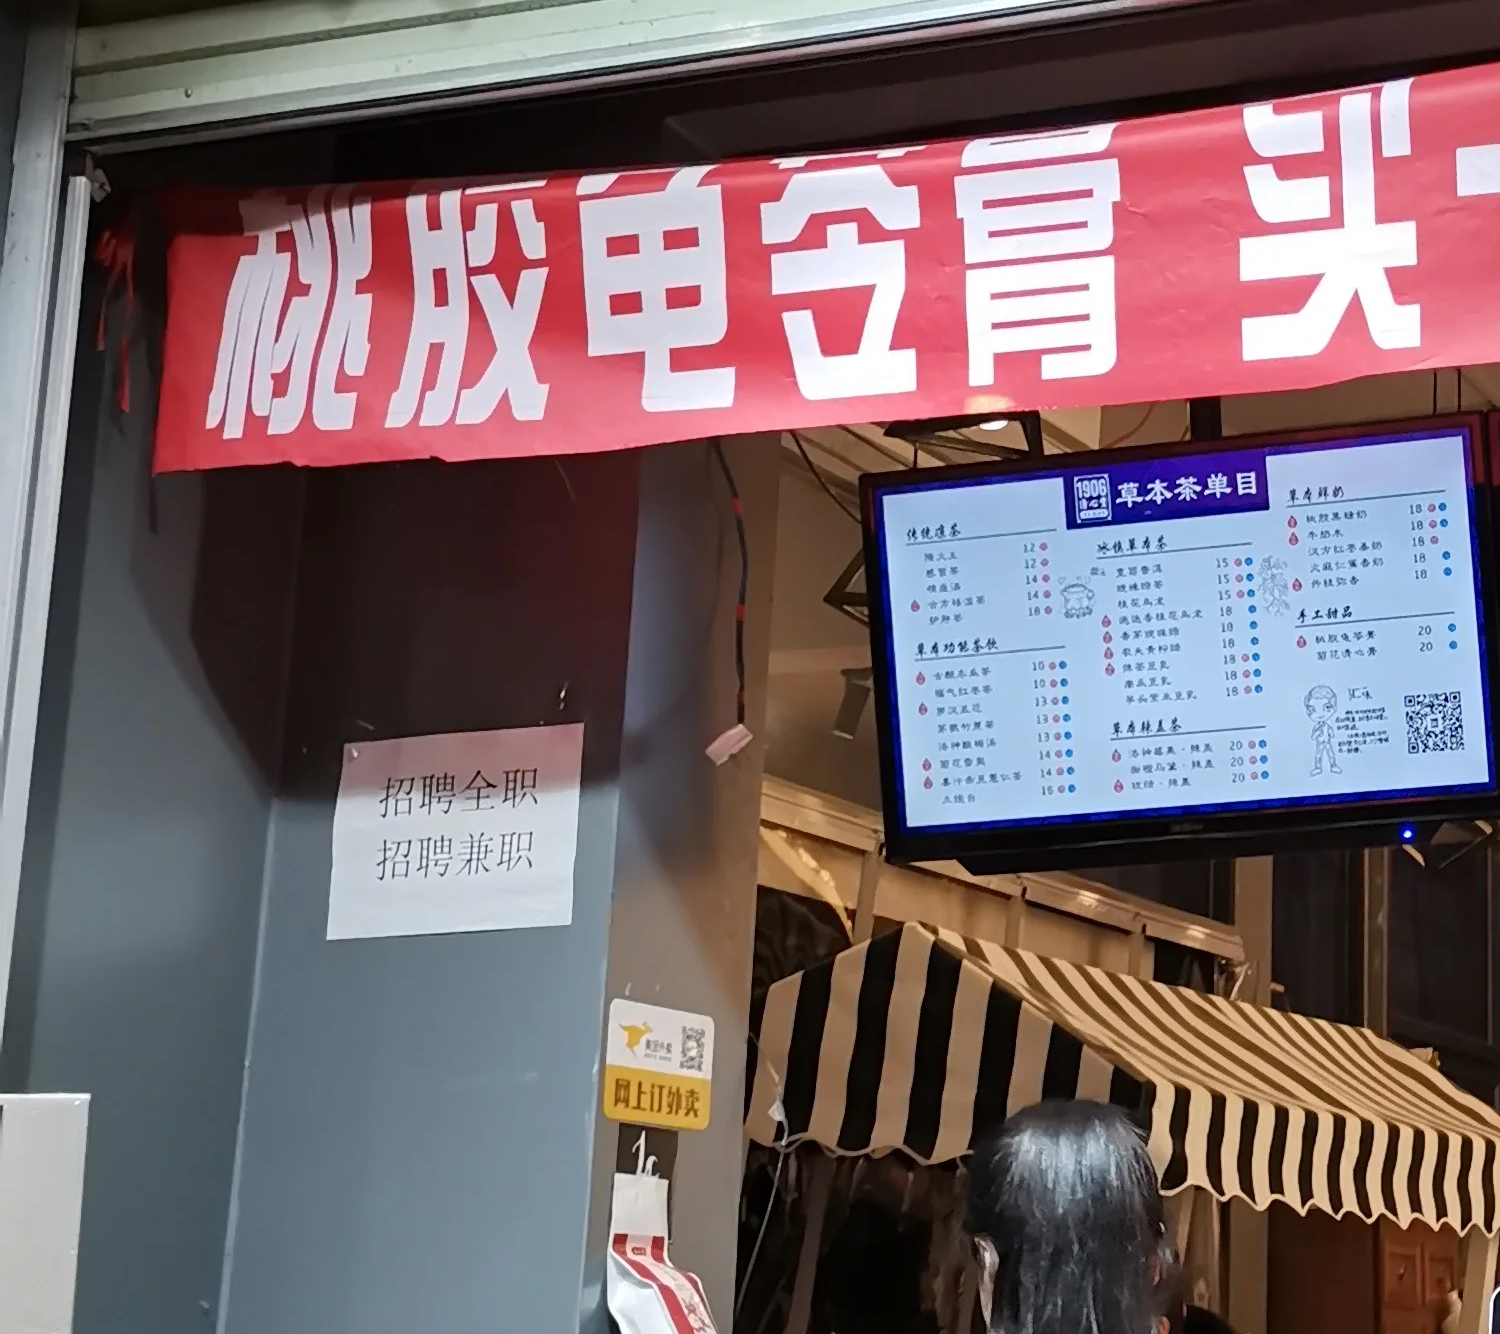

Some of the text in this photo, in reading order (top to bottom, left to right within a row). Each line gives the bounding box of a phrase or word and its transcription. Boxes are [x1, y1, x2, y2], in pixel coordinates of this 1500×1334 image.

[206, 123, 1121, 440] 桃胶龟苓膏
[1076, 478, 1108, 499] 1906
[1115, 470, 1257, 509] 草本茶单目
[1215, 557, 1229, 568] 15
[1413, 552, 1426, 563] 18
[1217, 574, 1230, 585] 15
[1219, 590, 1231, 601] 15
[1297, 605, 1353, 623] 手工甜品
[1418, 625, 1432, 636] 20
[1419, 641, 1433, 652] 20
[1223, 654, 1236, 665] 18
[1225, 670, 1238, 681] 18
[1229, 740, 1243, 752] 20
[1230, 756, 1244, 767] 20
[1231, 773, 1246, 784] 20
[378, 768, 539, 819] 招聘全职
[376, 831, 534, 881] 招聘兼职
[614, 1078, 700, 1119] 网上订外卖
